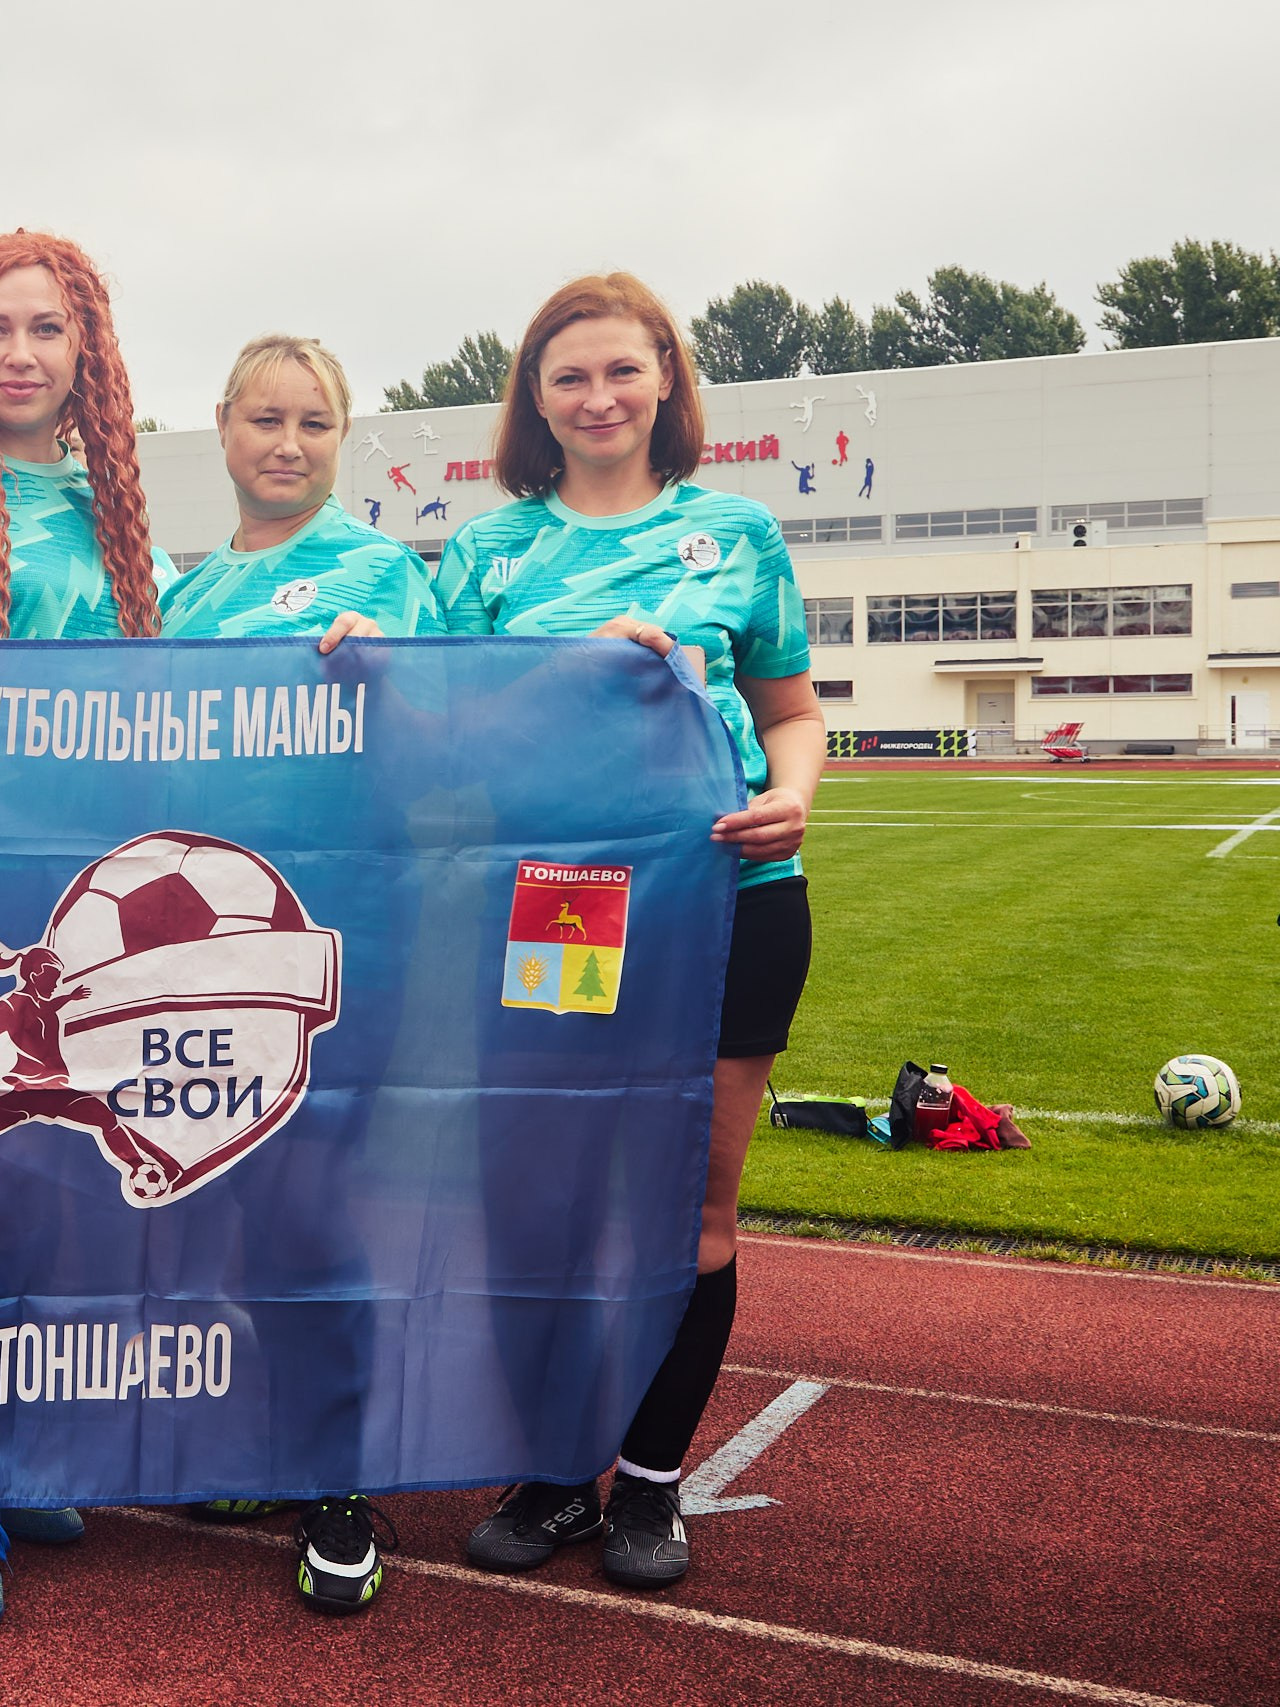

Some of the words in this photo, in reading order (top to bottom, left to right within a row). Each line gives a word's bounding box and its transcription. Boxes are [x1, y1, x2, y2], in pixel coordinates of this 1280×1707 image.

[233, 683, 366, 757] МАМЫ
[522, 866, 626, 882] ТОНШАЕВО
[143, 1028, 234, 1068] ВСЕ
[107, 1076, 263, 1119] СВОИ
